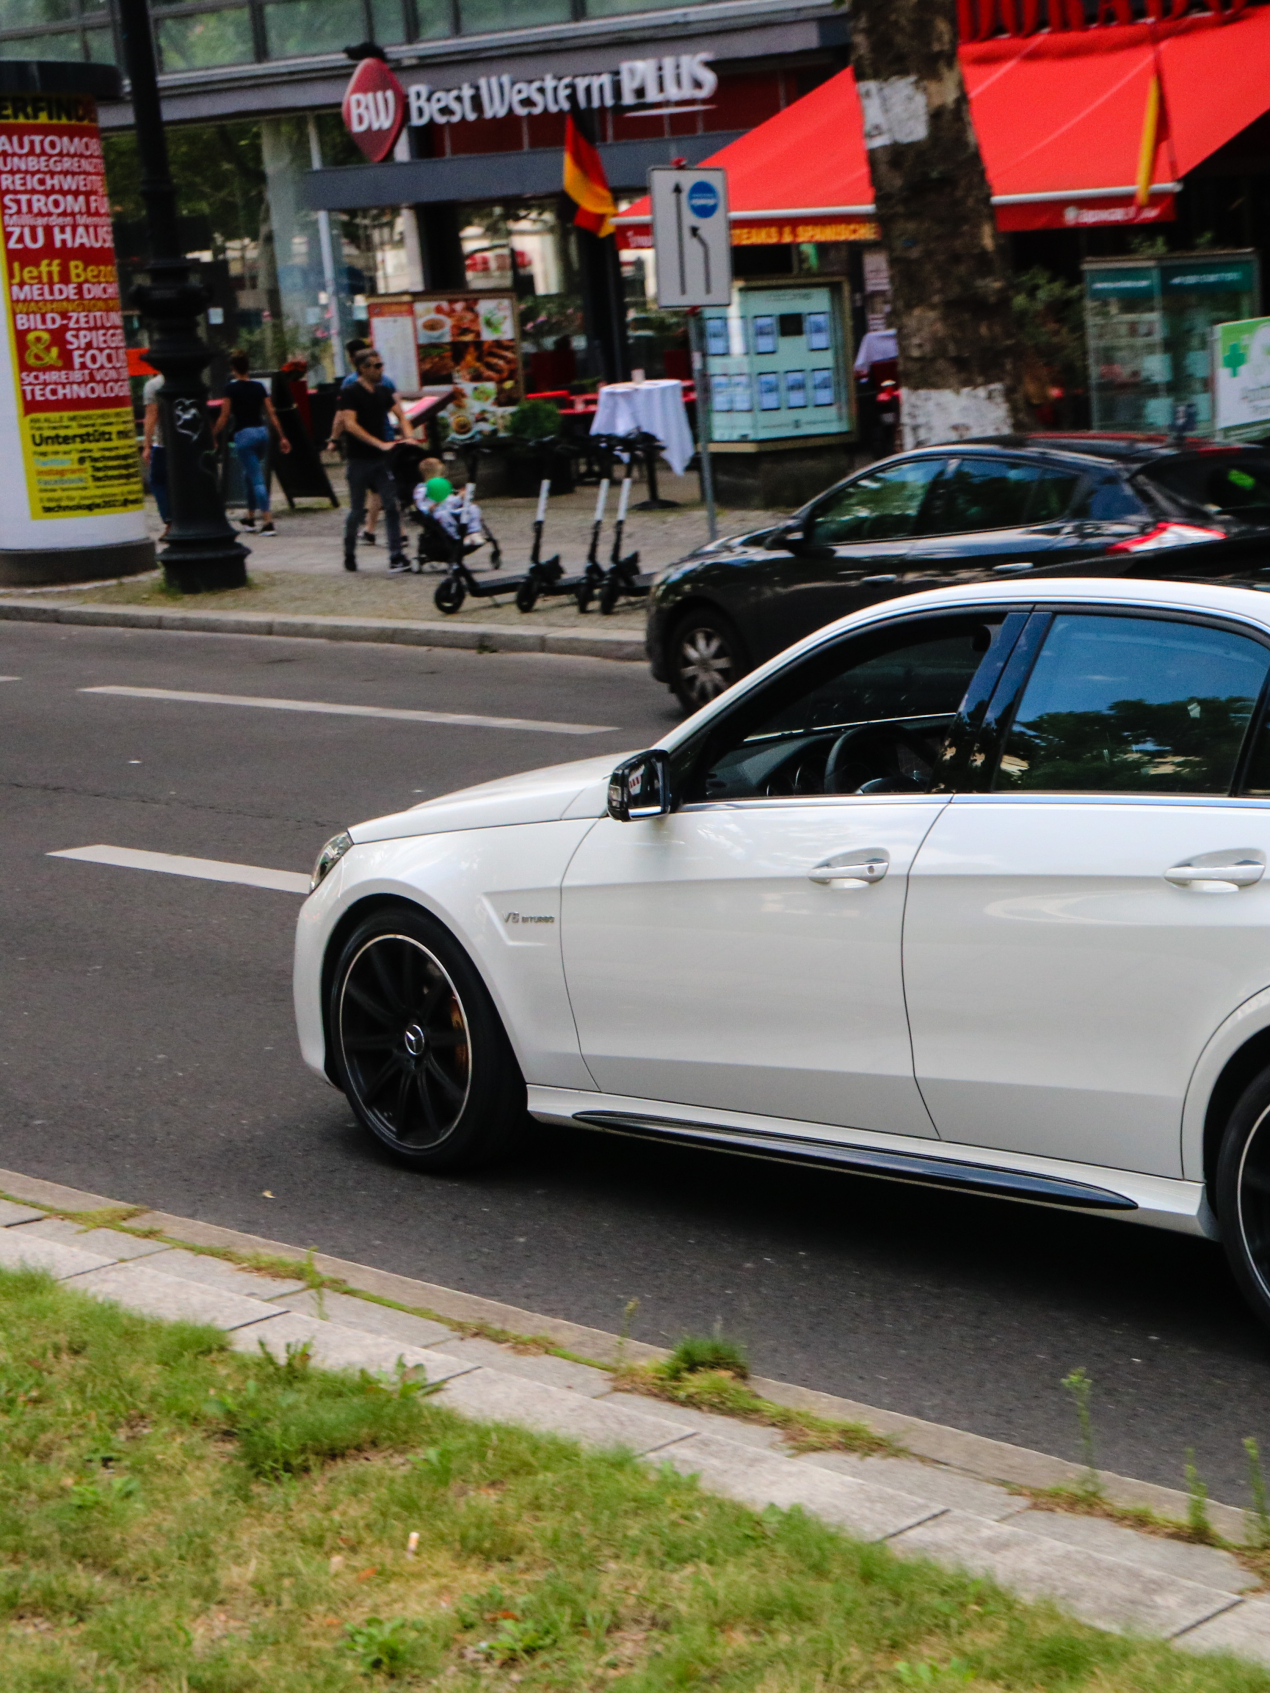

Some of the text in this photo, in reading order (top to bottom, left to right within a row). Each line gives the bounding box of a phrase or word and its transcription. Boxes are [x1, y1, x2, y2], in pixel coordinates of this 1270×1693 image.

[407, 52, 718, 126] Best Western PLUS
[350, 89, 395, 133] BW
[4, 188, 111, 214] STROM FÜ
[6, 226, 45, 249] ZU
[731, 226, 779, 246] TEAKS
[11, 259, 61, 284] Jeff
[11, 283, 79, 300] MELDE
[25, 330, 62, 367] &
[20, 370, 91, 384] SCHREIBT
